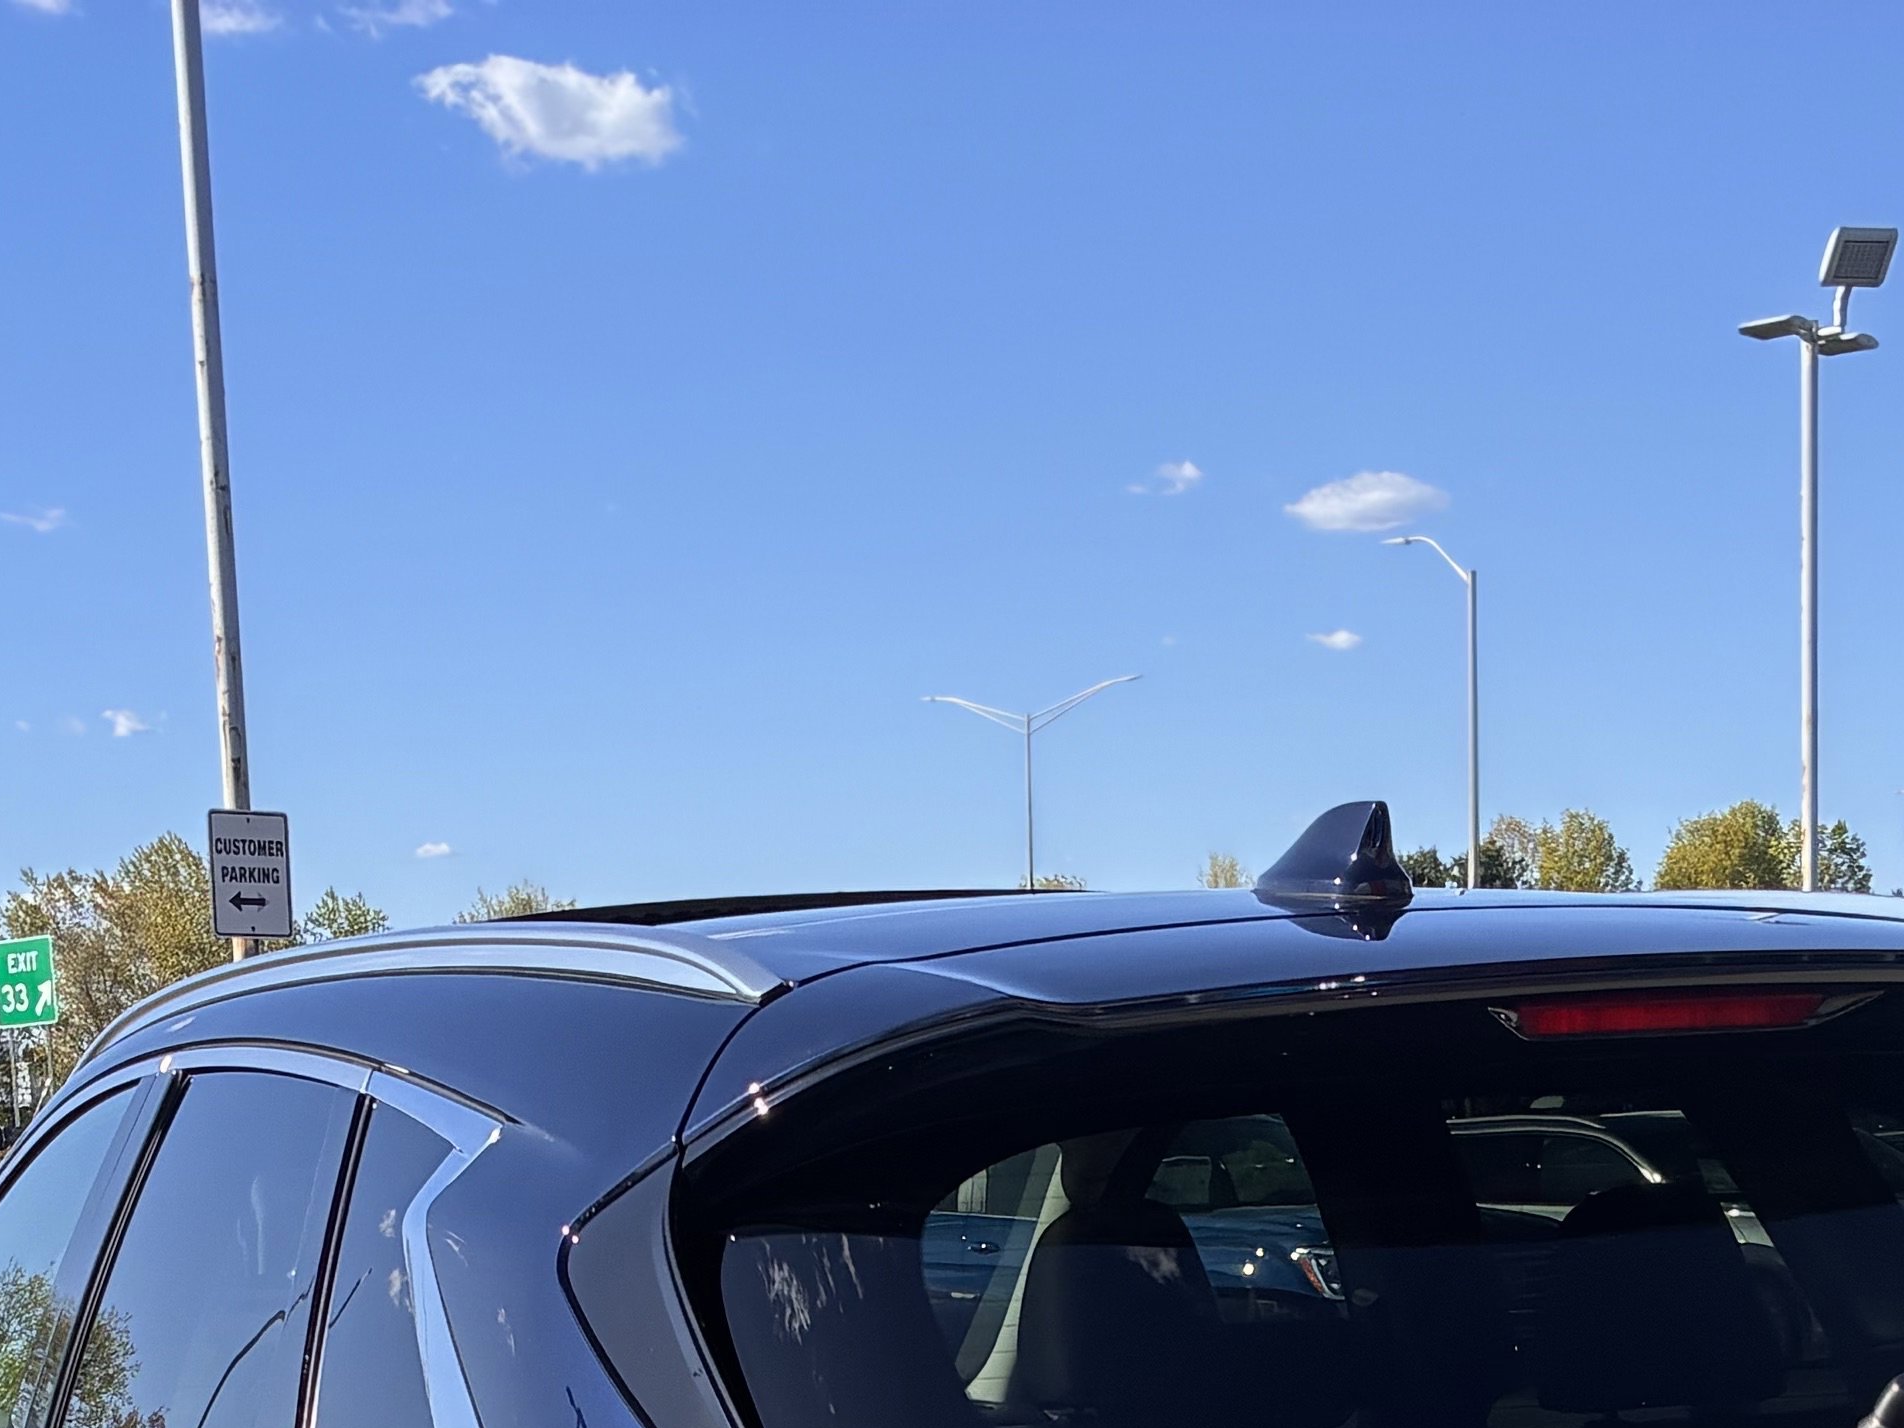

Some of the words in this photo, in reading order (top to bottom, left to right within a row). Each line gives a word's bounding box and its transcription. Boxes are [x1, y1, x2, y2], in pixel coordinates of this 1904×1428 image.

[214, 837, 285, 859] CUSTOMER
[220, 866, 280, 885] PARKING
[7, 950, 38, 974] EXIT
[1, 983, 30, 1014] 33
